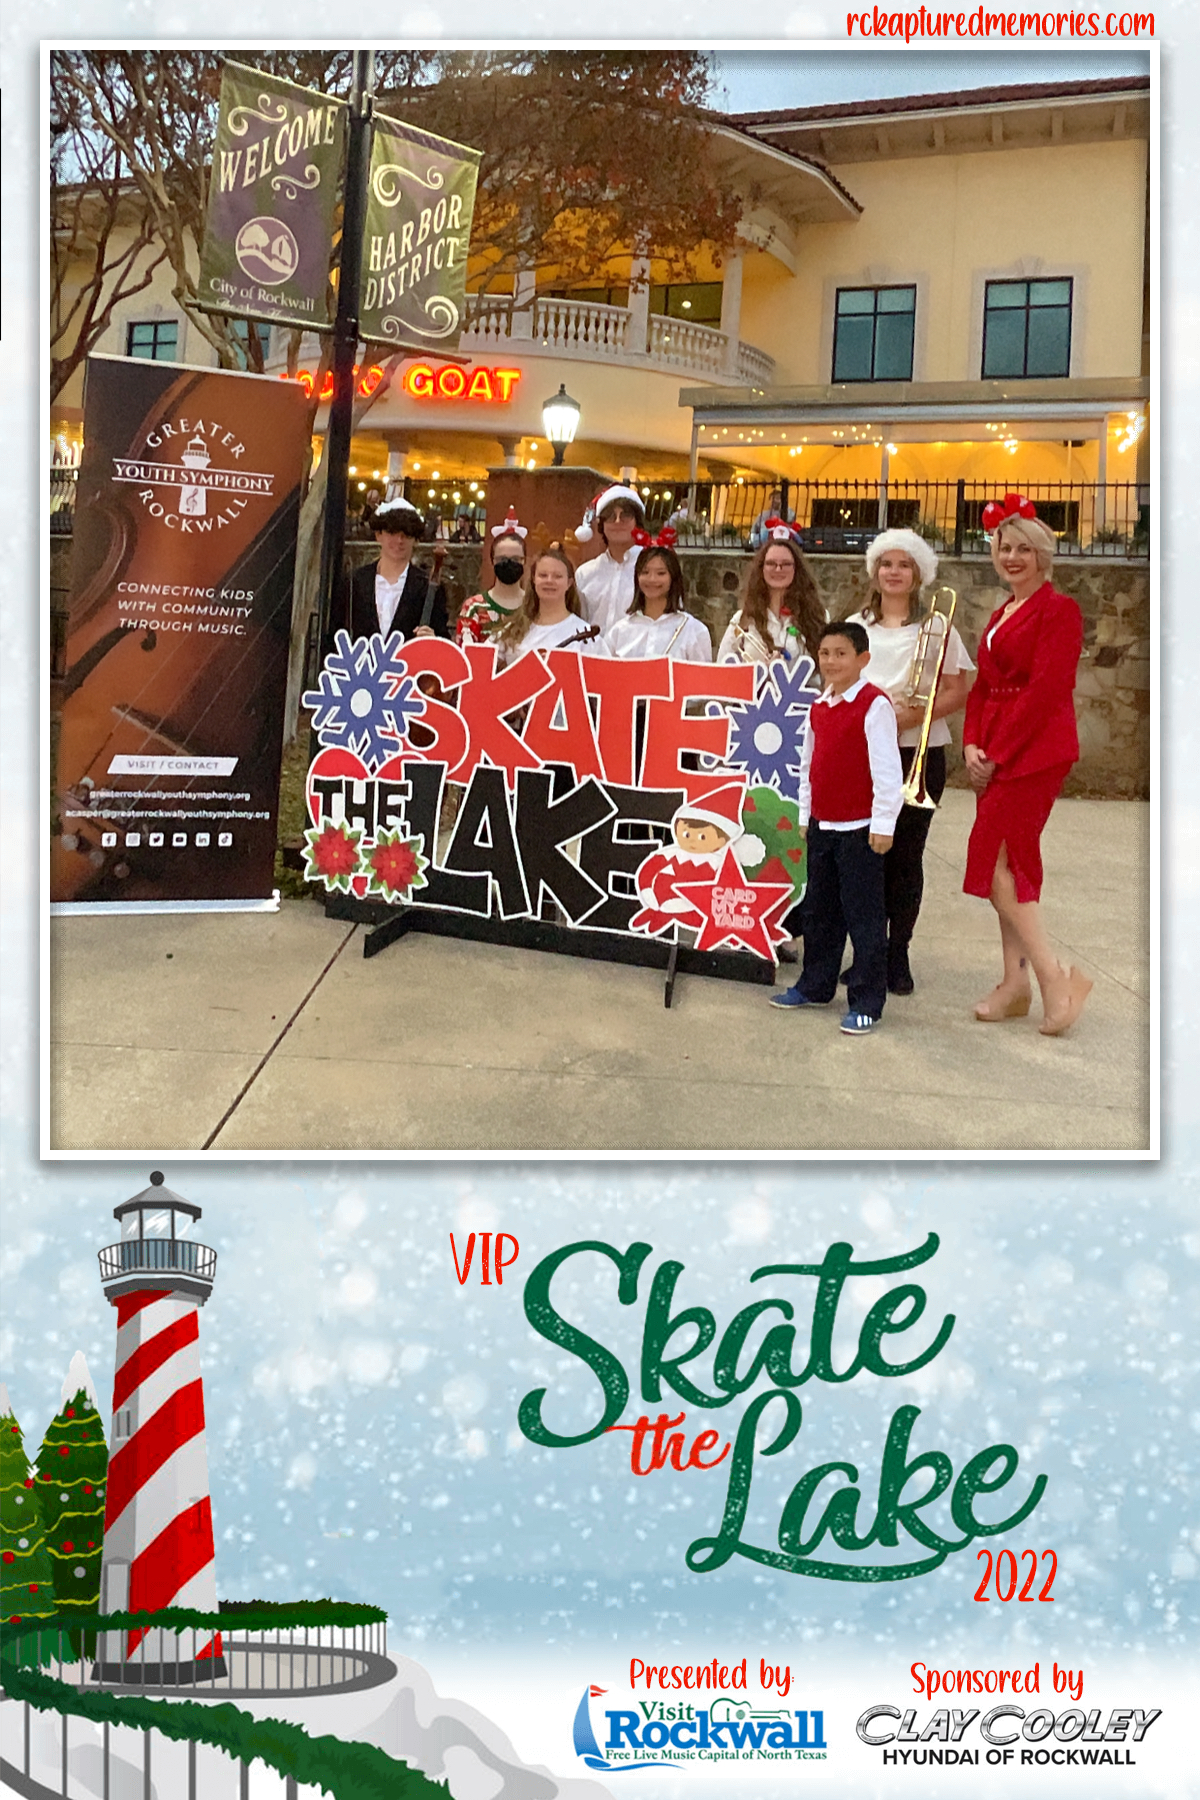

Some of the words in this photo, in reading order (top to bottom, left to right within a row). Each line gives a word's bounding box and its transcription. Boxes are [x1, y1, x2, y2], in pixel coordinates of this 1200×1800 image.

[219, 105, 339, 193] WELCOME
[369, 194, 463, 272] HARBOR
[363, 236, 460, 311] DISTRICT
[209, 277, 237, 297] City
[240, 286, 256, 300] of
[257, 288, 315, 312] Rockwall
[404, 363, 521, 402] GOAT
[146, 418, 246, 460] GREATER
[115, 463, 176, 482] YOUTH
[179, 470, 273, 491] SYMPHONY
[138, 488, 248, 534] ROCKWALL
[117, 582, 215, 598] CONNECTING
[220, 588, 254, 601] KIDS
[118, 600, 157, 612] WITH
[162, 603, 253, 619] COMMUNITY
[119, 618, 193, 633] THROUGH
[197, 622, 247, 636] MUSIC.
[385, 637, 758, 797] SKATE
[127, 760, 155, 769] VISIT
[167, 761, 219, 770] CONTACT
[89, 789, 251, 802] greaterrockwallyouthsymphony.org
[309, 774, 413, 844] THE
[398, 760, 689, 944] LAKE
[711, 898, 738, 916] MY
[712, 886, 757, 905] CARD
[713, 913, 755, 930] YARD
